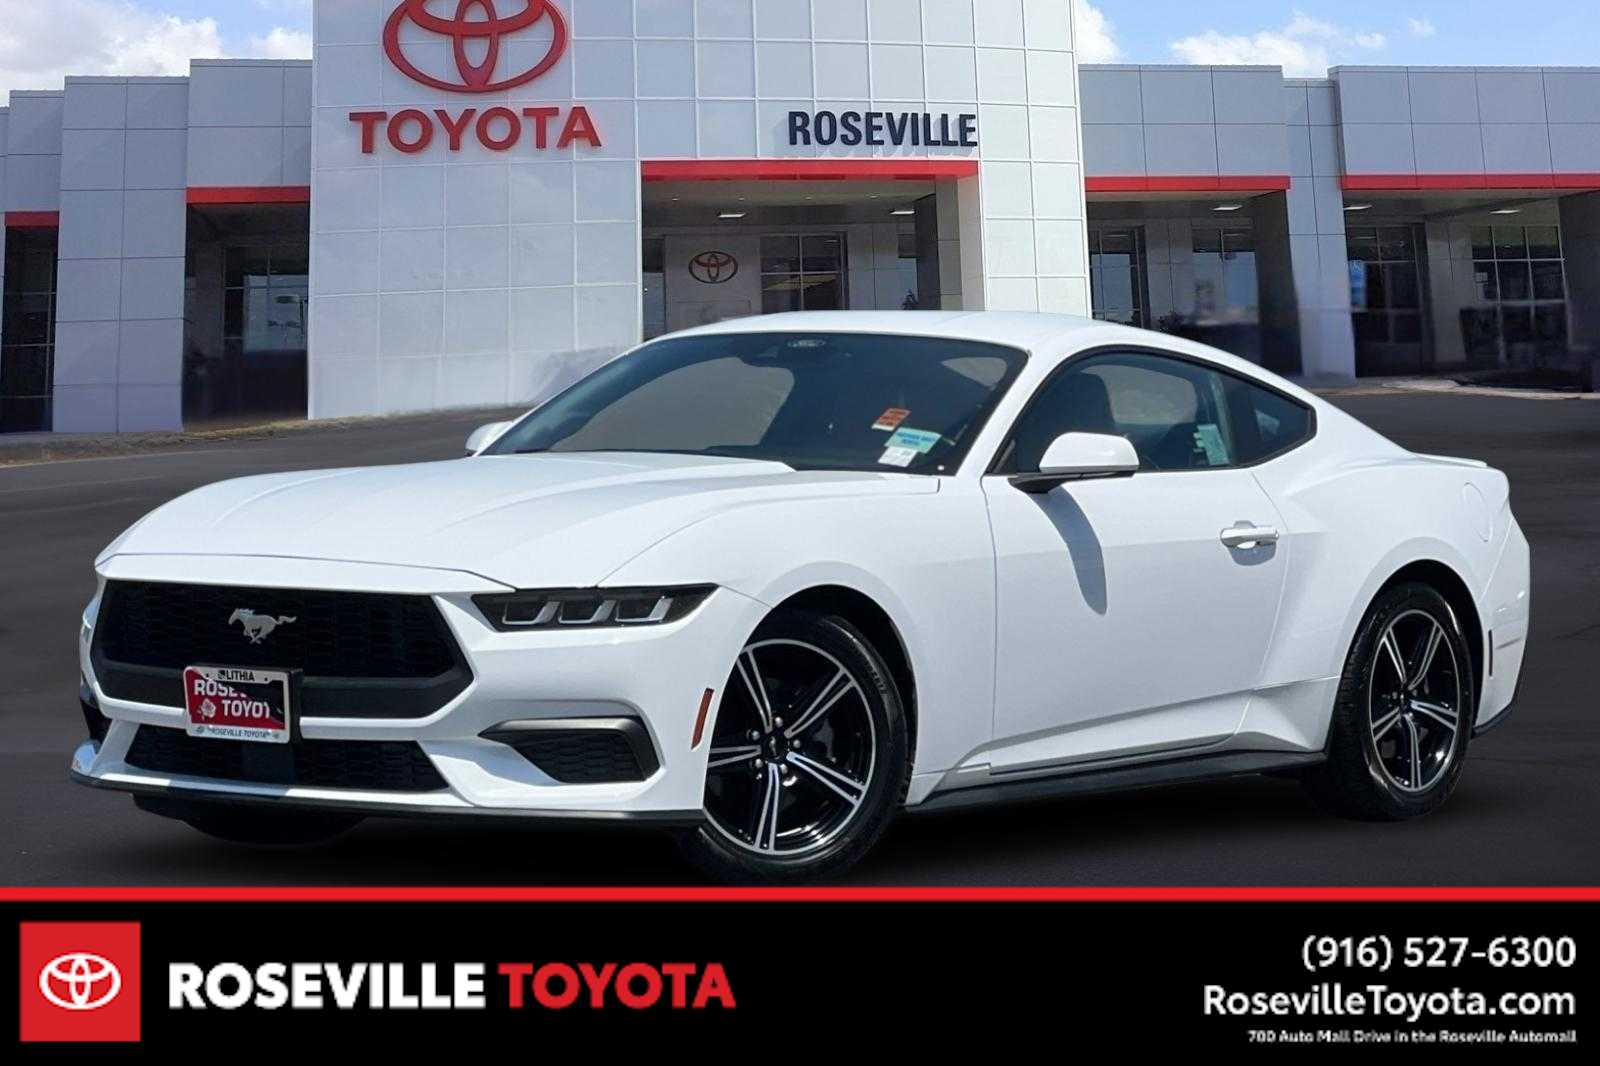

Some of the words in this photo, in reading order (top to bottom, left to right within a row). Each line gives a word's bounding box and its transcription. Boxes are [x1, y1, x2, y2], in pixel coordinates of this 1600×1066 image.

[349, 106, 602, 154] TOYOTA
[789, 111, 978, 147] ROSEVILLE
[226, 670, 255, 681] LITHIA
